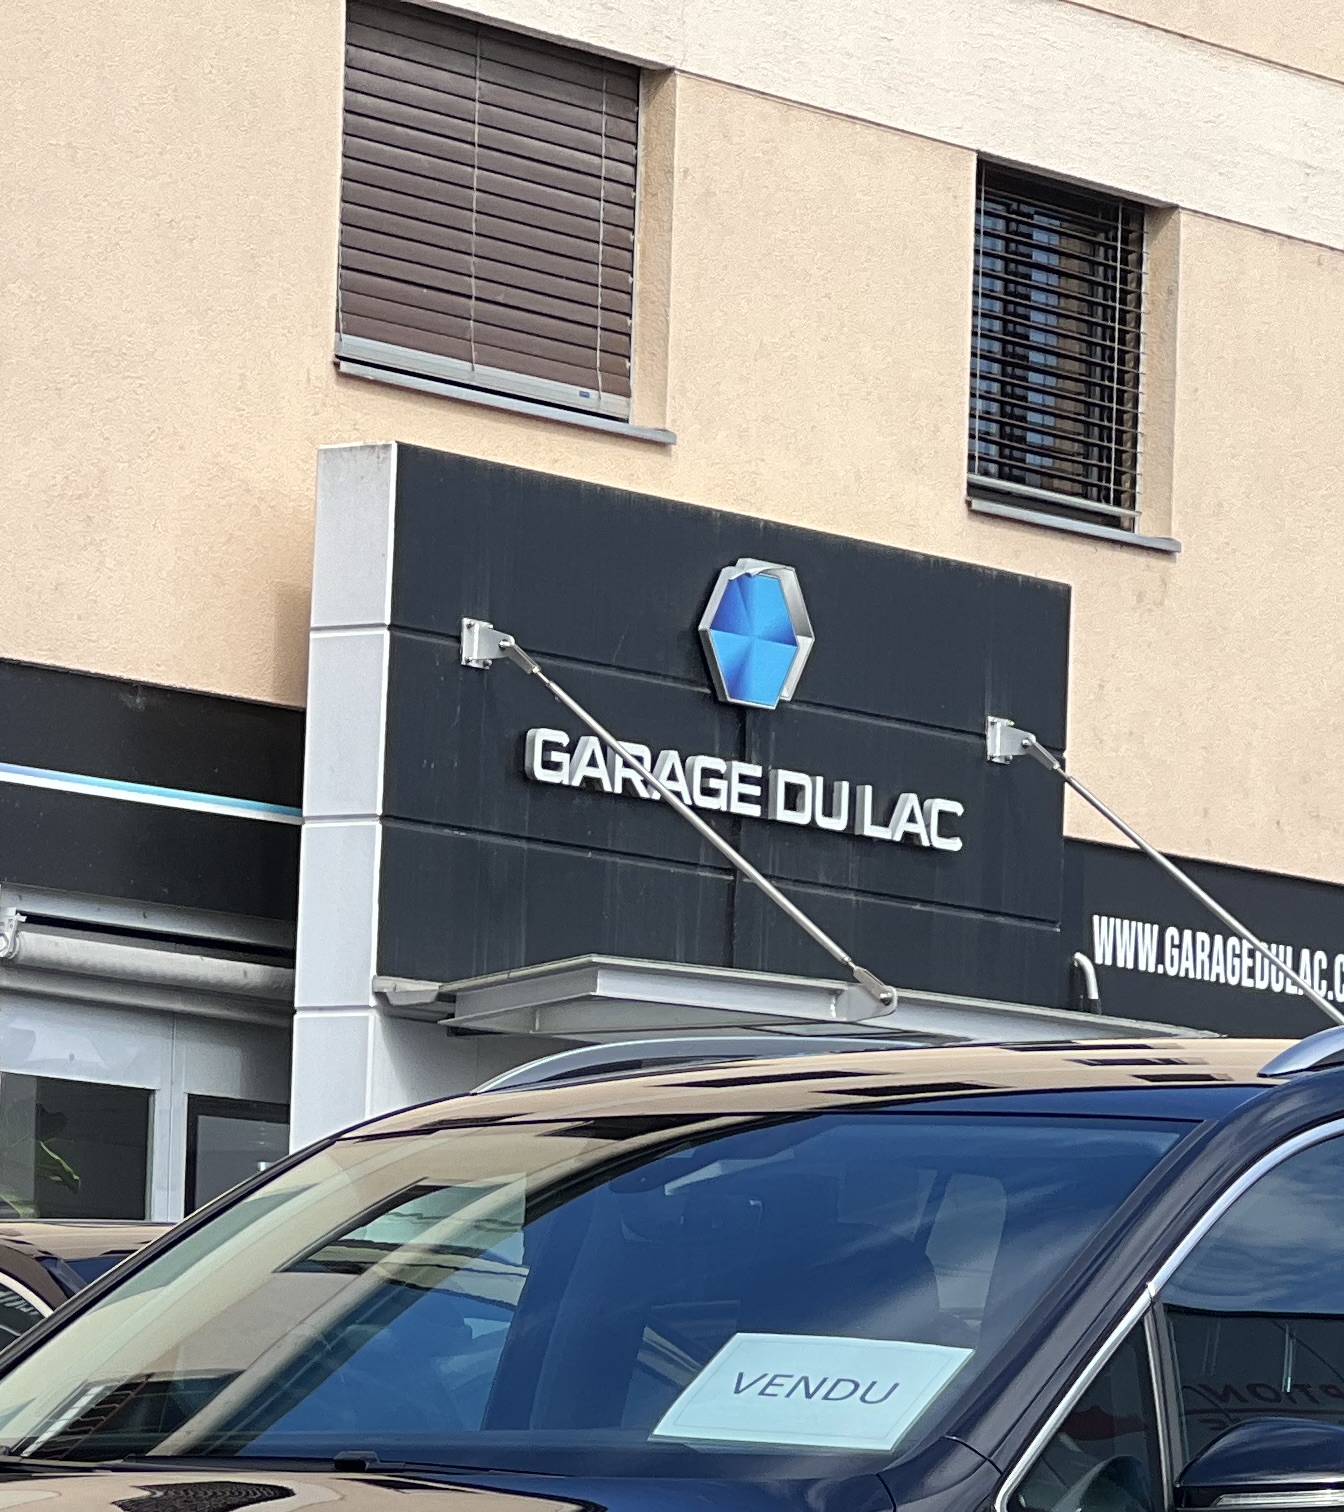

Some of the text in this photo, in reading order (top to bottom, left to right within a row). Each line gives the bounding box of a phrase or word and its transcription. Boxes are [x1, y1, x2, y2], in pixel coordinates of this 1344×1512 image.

[525, 727, 964, 851] GARAGE DU LAC
[733, 1371, 900, 1405] VENDU
